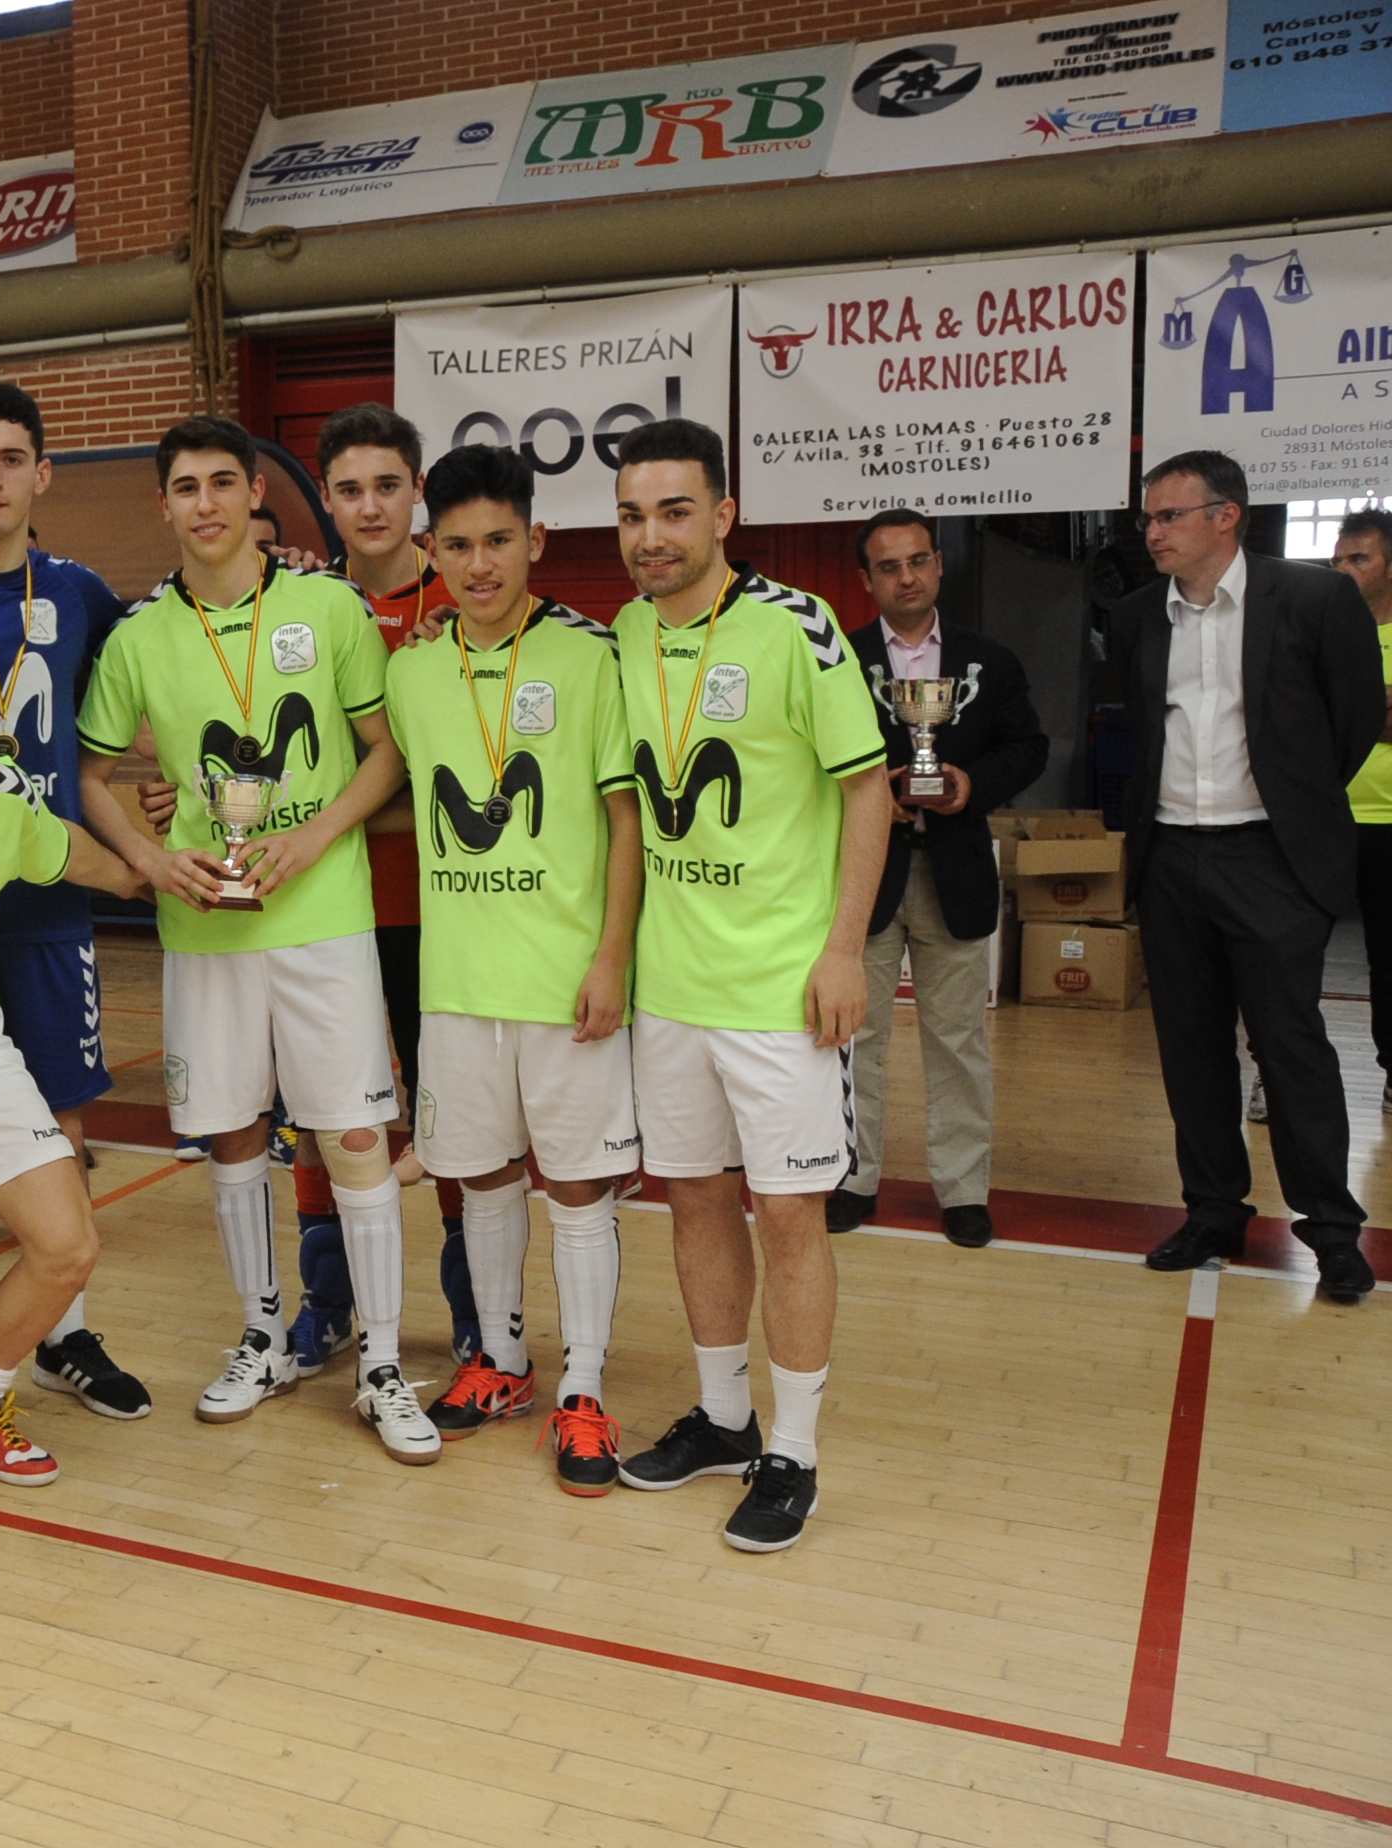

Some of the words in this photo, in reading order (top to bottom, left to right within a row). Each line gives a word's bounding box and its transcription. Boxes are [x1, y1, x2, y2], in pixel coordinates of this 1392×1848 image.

[1038, 12, 1180, 44] PHOTOGRAPHY
[1263, 7, 1384, 34] Móstoles
[1266, 29, 1352, 49] Carlos
[1362, 21, 1380, 34] V
[1053, 58, 1081, 67] TELF.
[1229, 54, 1282, 70] 610
[1293, 44, 1348, 62] 848
[996, 47, 1216, 88] WWW.FOTO-FUTSAL.ES
[1091, 108, 1198, 134] CLUB
[1069, 122, 1196, 142] www.todoparatuclub.com
[737, 139, 812, 156] BRAVO
[523, 159, 620, 177] METALES
[319, 180, 393, 197] Logístico
[828, 296, 922, 346] IRRA
[936, 307, 963, 339] &
[977, 277, 1127, 336] CARLOS
[1164, 311, 1192, 342] M
[428, 344, 567, 376] TALLERES
[580, 328, 693, 367] PRIZÁN
[1201, 286, 1274, 415] A
[878, 345, 1067, 393] CARNICERIA
[753, 428, 839, 447] GALERIA
[848, 425, 886, 441] LAS
[896, 420, 976, 437] LOMAS
[999, 416, 1073, 432] Puesto
[1083, 412, 1112, 427] 28
[1261, 425, 1307, 438] Ciudad
[1312, 422, 1364, 436] Dolores
[762, 450, 786, 464] C/
[859, 444, 884, 458] 38
[915, 440, 949, 455] Tlf.
[960, 431, 1100, 452] 916461068
[1284, 441, 1325, 455] 28931
[861, 456, 990, 476] (MOSTOLES)
[1261, 461, 1276, 474] 07
[1281, 460, 1297, 473] 55
[1311, 459, 1336, 471] Fax:
[1341, 457, 1357, 469] 91
[1363, 455, 1388, 468] 614
[1249, 475, 1379, 492] oria@albalexmg.es
[823, 497, 906, 512] Servicio
[915, 496, 925, 507] a
[934, 489, 1033, 506] domicilio
[279, 625, 305, 637] inter
[714, 667, 741, 678] inter
[522, 684, 548, 694] inter
[431, 867, 546, 893] movistar
[1059, 971, 1086, 983] FRIT
[365, 1084, 394, 1103] hummel
[787, 1149, 840, 1169] hummel
